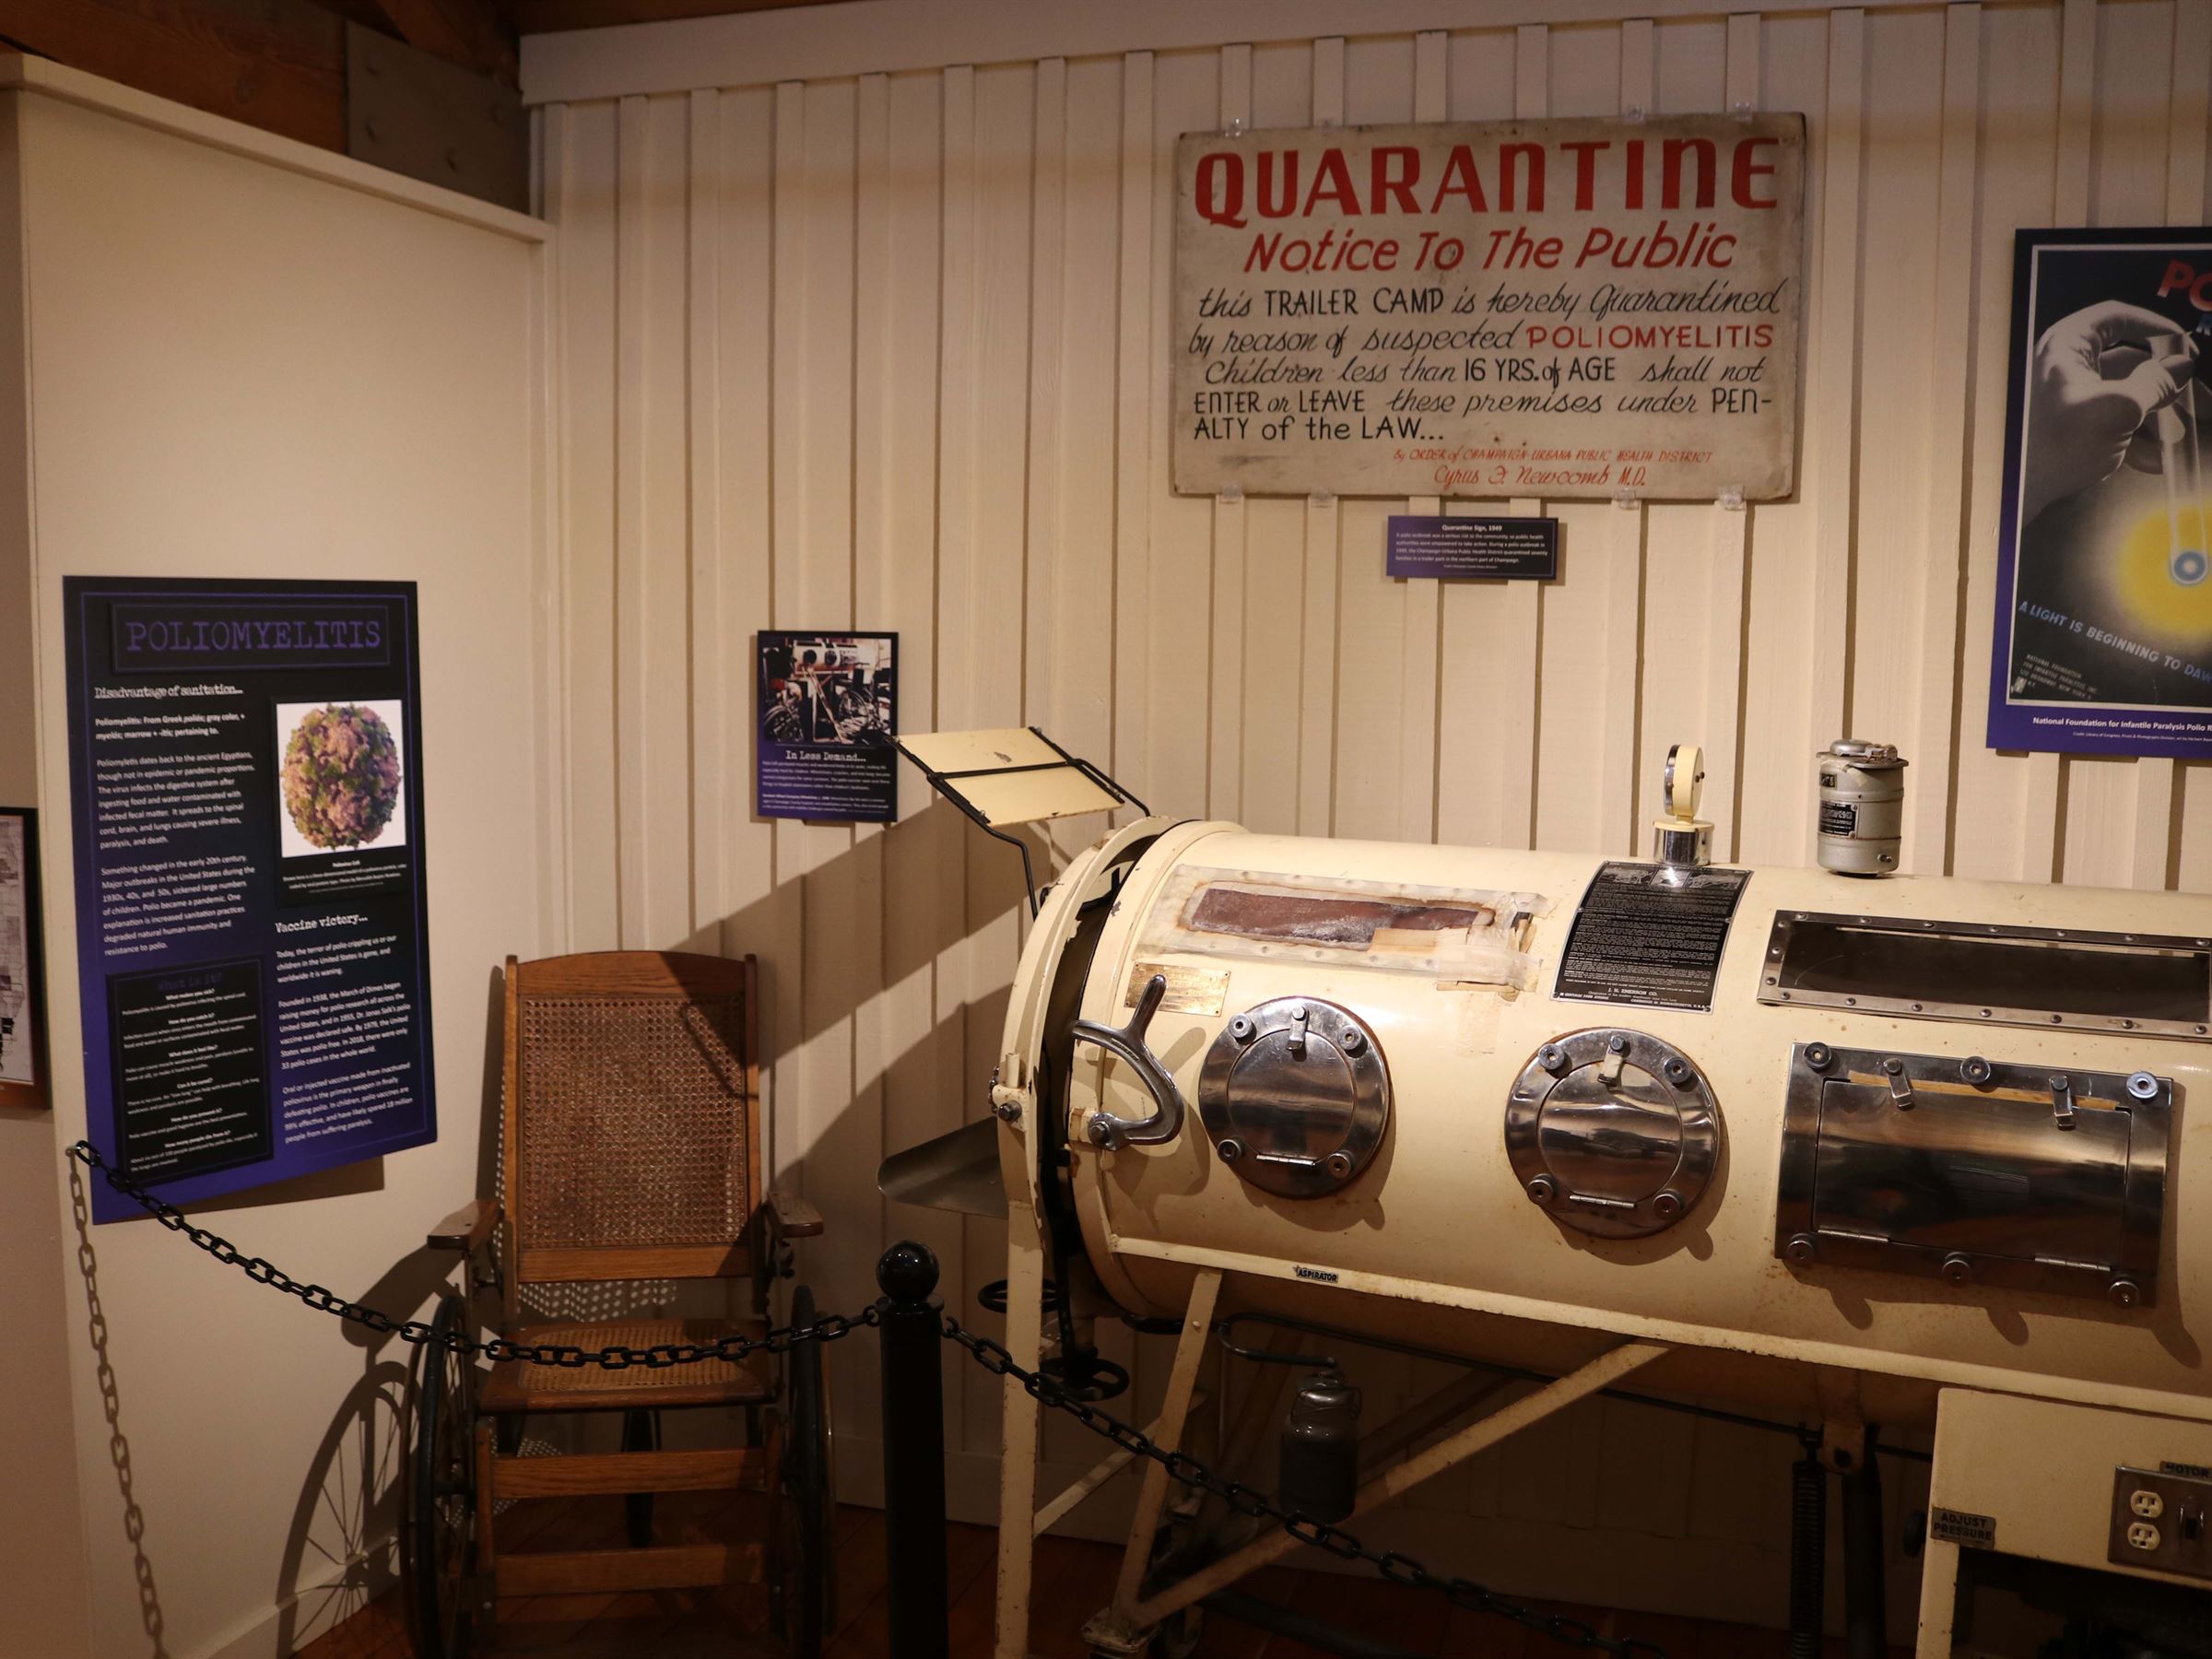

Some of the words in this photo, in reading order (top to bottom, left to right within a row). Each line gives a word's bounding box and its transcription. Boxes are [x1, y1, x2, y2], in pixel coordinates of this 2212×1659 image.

[1194, 136, 1780, 229] QUARANTINE
[1243, 229, 1400, 273] Notice
[1415, 231, 1465, 271] To
[1482, 226, 1564, 270] The
[1574, 219, 1737, 269] Public
[1198, 287, 1253, 318] this
[1264, 288, 1359, 317] TRAILER
[1372, 287, 1444, 315] CAMP
[1452, 286, 1477, 315] is
[1487, 281, 1582, 322] hereby
[1589, 277, 1789, 322] Quarantined
[1188, 323, 1215, 359] by
[1222, 329, 1319, 353] reason
[1325, 324, 1349, 359] of
[1361, 319, 1524, 363] suspected
[1526, 324, 1774, 349] POLIOMYELITIS
[1205, 356, 1324, 384] Children
[1338, 356, 1387, 382] less
[1399, 357, 1457, 382] than
[1465, 358, 1487, 382] 16
[1495, 358, 1540, 382] YRS.
[1541, 356, 1561, 389] of
[1568, 357, 1616, 382] AGE
[1639, 355, 1713, 382] shall
[1719, 356, 1767, 382] not
[1194, 391, 1261, 414] ENTER
[1267, 395, 1292, 413] or
[1299, 390, 1365, 413] LEAVE
[1386, 387, 1457, 413] these
[1463, 391, 1603, 418] premises
[1617, 385, 1699, 413] under
[1712, 387, 1772, 414] PEN-
[1194, 417, 1249, 441] ALTY
[1261, 415, 1295, 441] of
[1305, 417, 1351, 441] the
[1361, 416, 1445, 441] LAW...
[1393, 450, 1406, 463] By
[1409, 449, 1446, 461] ORDER
[1447, 446, 1463, 462] of
[1575, 449, 1612, 461] PUBLIC
[1617, 450, 1653, 461] HEALTH
[1658, 450, 1714, 463] DISTRICT
[1433, 465, 1479, 490] Cyrus
[1515, 464, 1610, 485] Newcomb
[1618, 465, 1646, 487] M.D.
[125, 620, 382, 651] POLIOMYELITIS
[2018, 601, 2027, 612] A
[2030, 605, 2068, 626] LIGHT
[2069, 620, 2083, 632] IS
[2087, 626, 2160, 663] BEGINNING
[2164, 655, 2181, 670] TO
[94, 687, 167, 700] Disadvantage
[168, 685, 179, 697] of
[181, 684, 243, 695] sanitation...
[2065, 718, 2107, 727] Foundation
[2121, 721, 2152, 729] Infantile
[2153, 723, 2184, 732] Paralysis
[140, 757, 158, 765] dates
[196, 753, 220, 761] ancient
[221, 751, 253, 760] Egyptians,
[785, 750, 797, 759] In
[800, 751, 821, 760] Less
[823, 752, 866, 762] Demand...
[98, 772, 122, 782] though
[145, 769, 175, 778] epidemic
[184, 767, 216, 776] pandemic
[217, 764, 255, 773] proportions.
[167, 782, 195, 790] digestive
[196, 780, 218, 788] system
[99, 800, 129, 809] ingesting
[131, 796, 147, 805] food
[182, 793, 226, 802] contaminated
[227, 790, 241, 798] with
[99, 812, 127, 821] infected
[128, 810, 145, 819] fecal
[179, 806, 204, 816] spreads
[225, 803, 243, 812] spinal
[100, 826, 118, 835] cord,
[119, 825, 138, 834] brain,
[140, 824, 153, 832] and
[100, 840, 132, 850] paralysis,
[147, 835, 169, 844] death.
[275, 920, 318, 934] Vaccine
[318, 913, 369, 927] victory...
[1298, 1269, 1337, 1281] ASPIRATOR
[2163, 1463, 2211, 1478] MOTOR
[1940, 1512, 1987, 1528] ADJUST
[1934, 1523, 1993, 1541] PRESSURE
